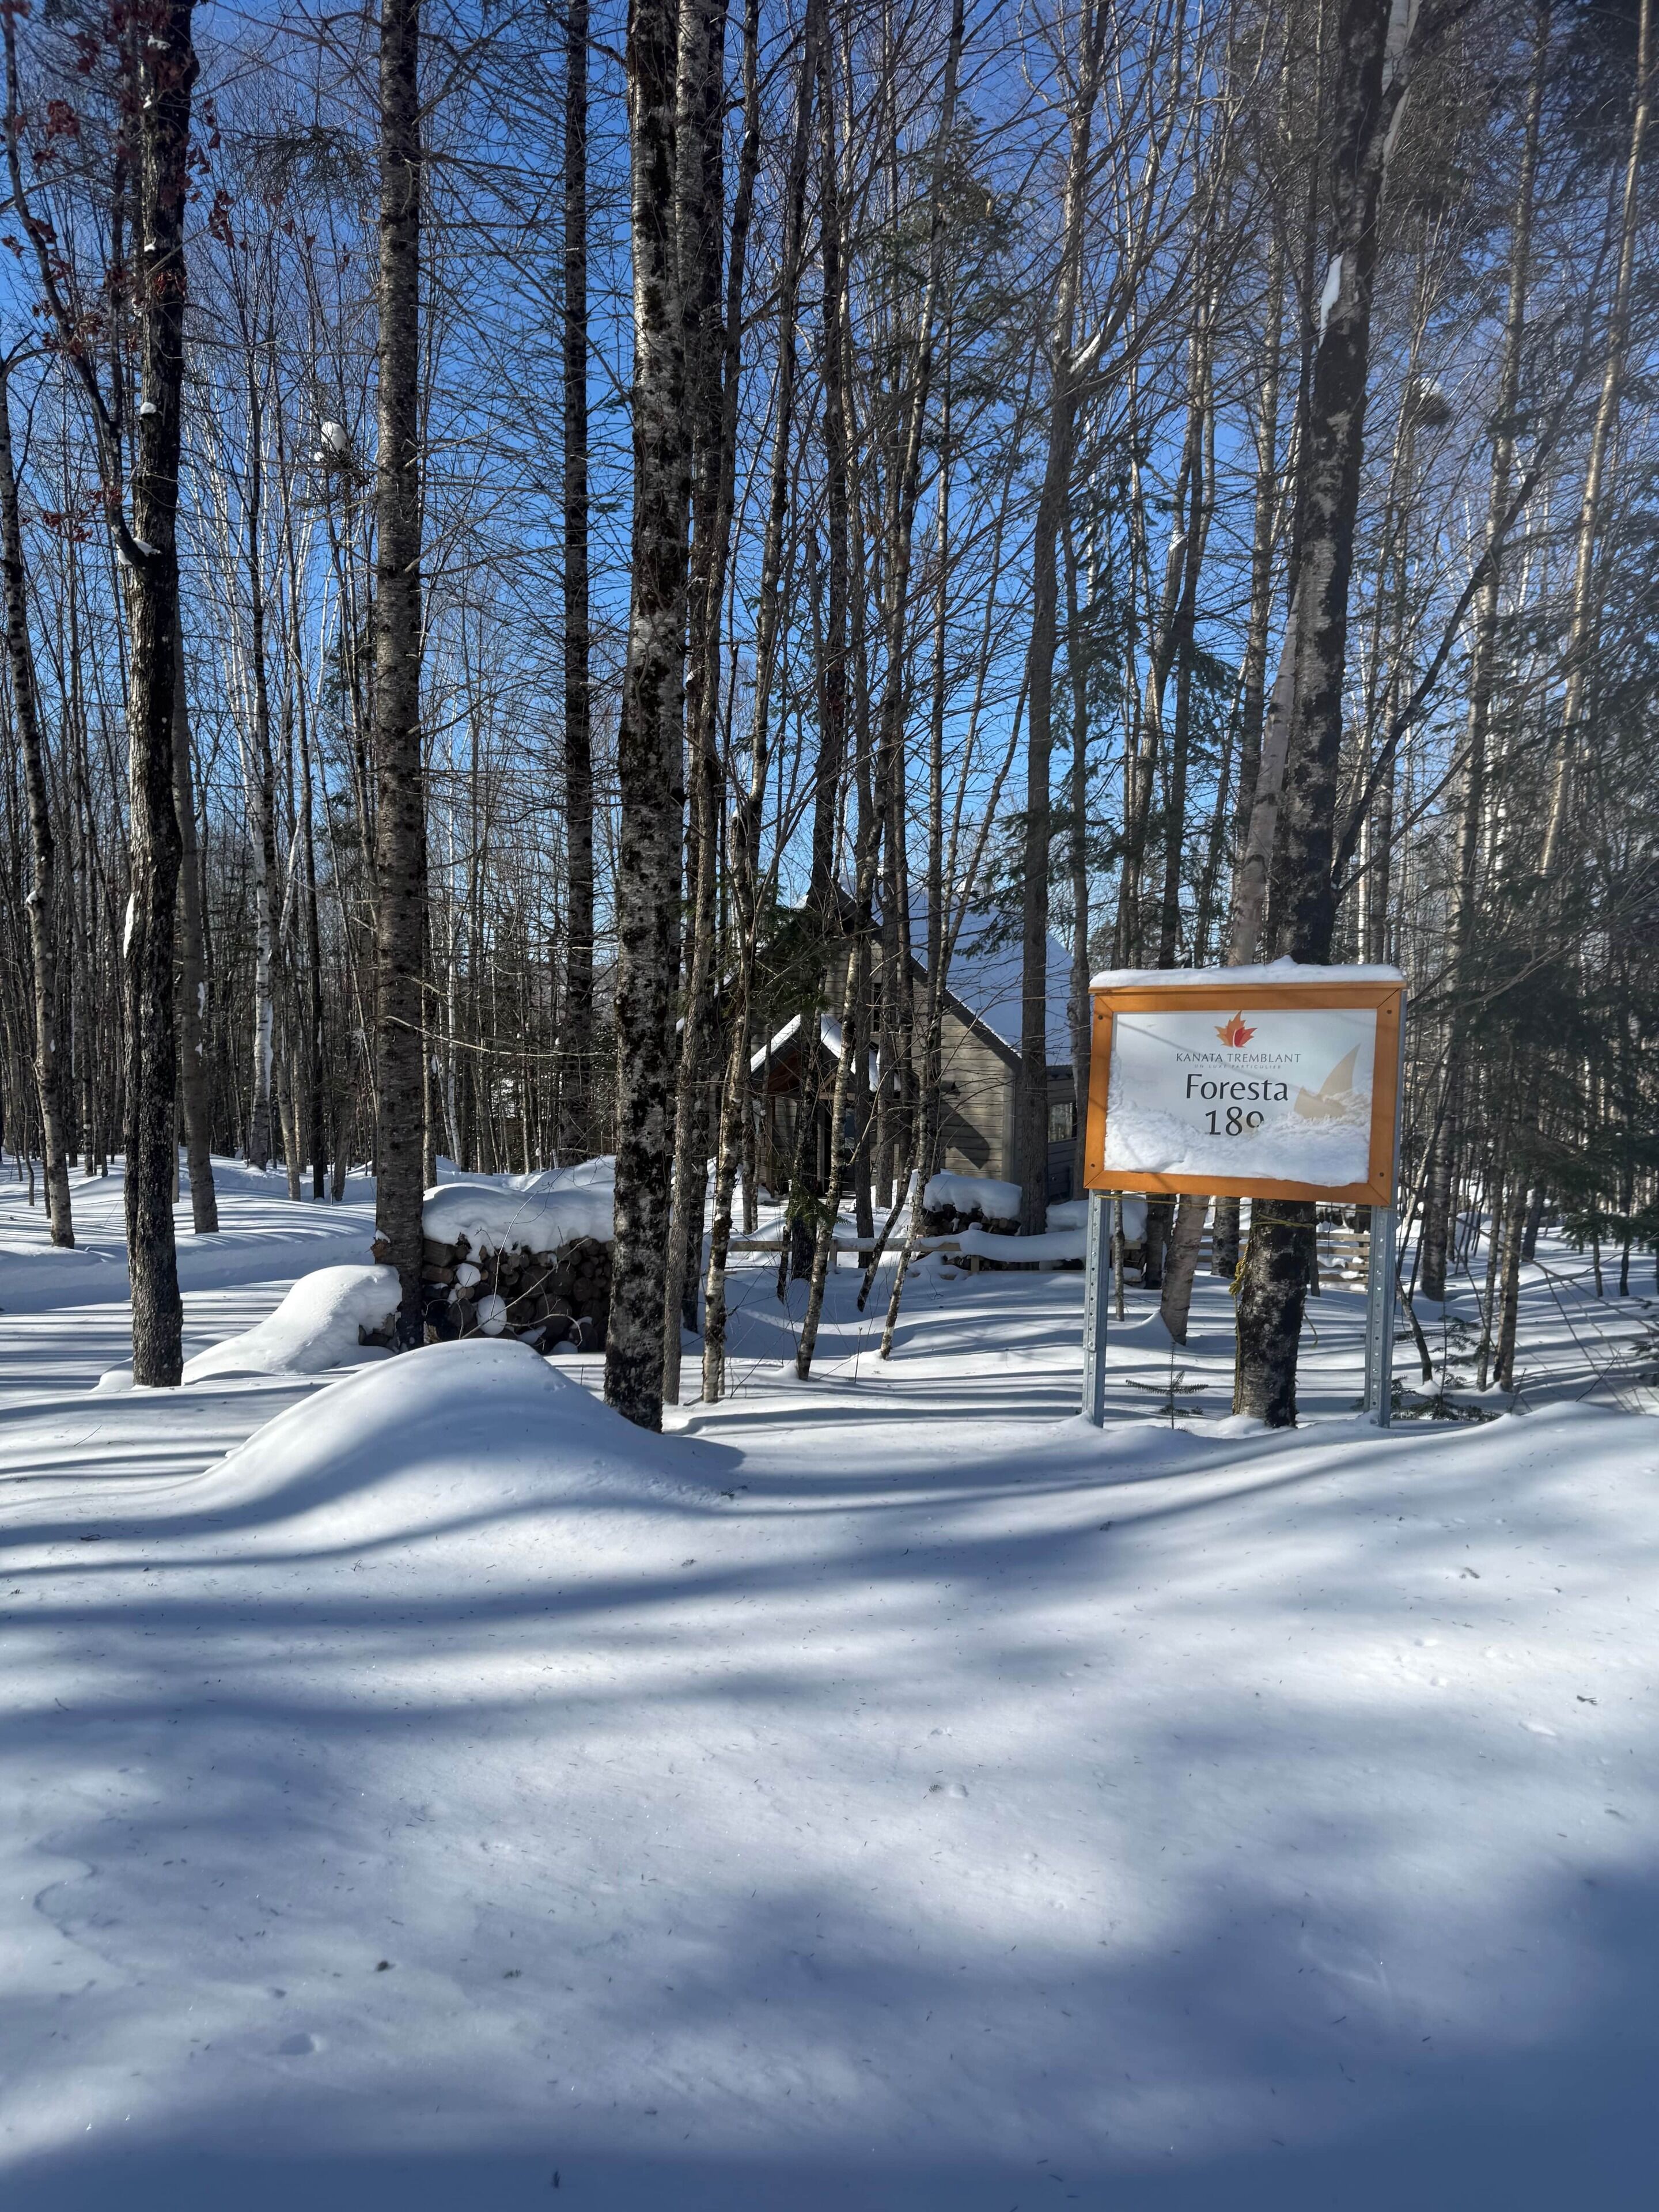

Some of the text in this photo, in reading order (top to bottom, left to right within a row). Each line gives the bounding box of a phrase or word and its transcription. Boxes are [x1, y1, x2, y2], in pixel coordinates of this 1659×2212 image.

[1176, 1053, 1301, 1063] KANATA TREMBLANT
[1186, 1074, 1289, 1101] Foresta
